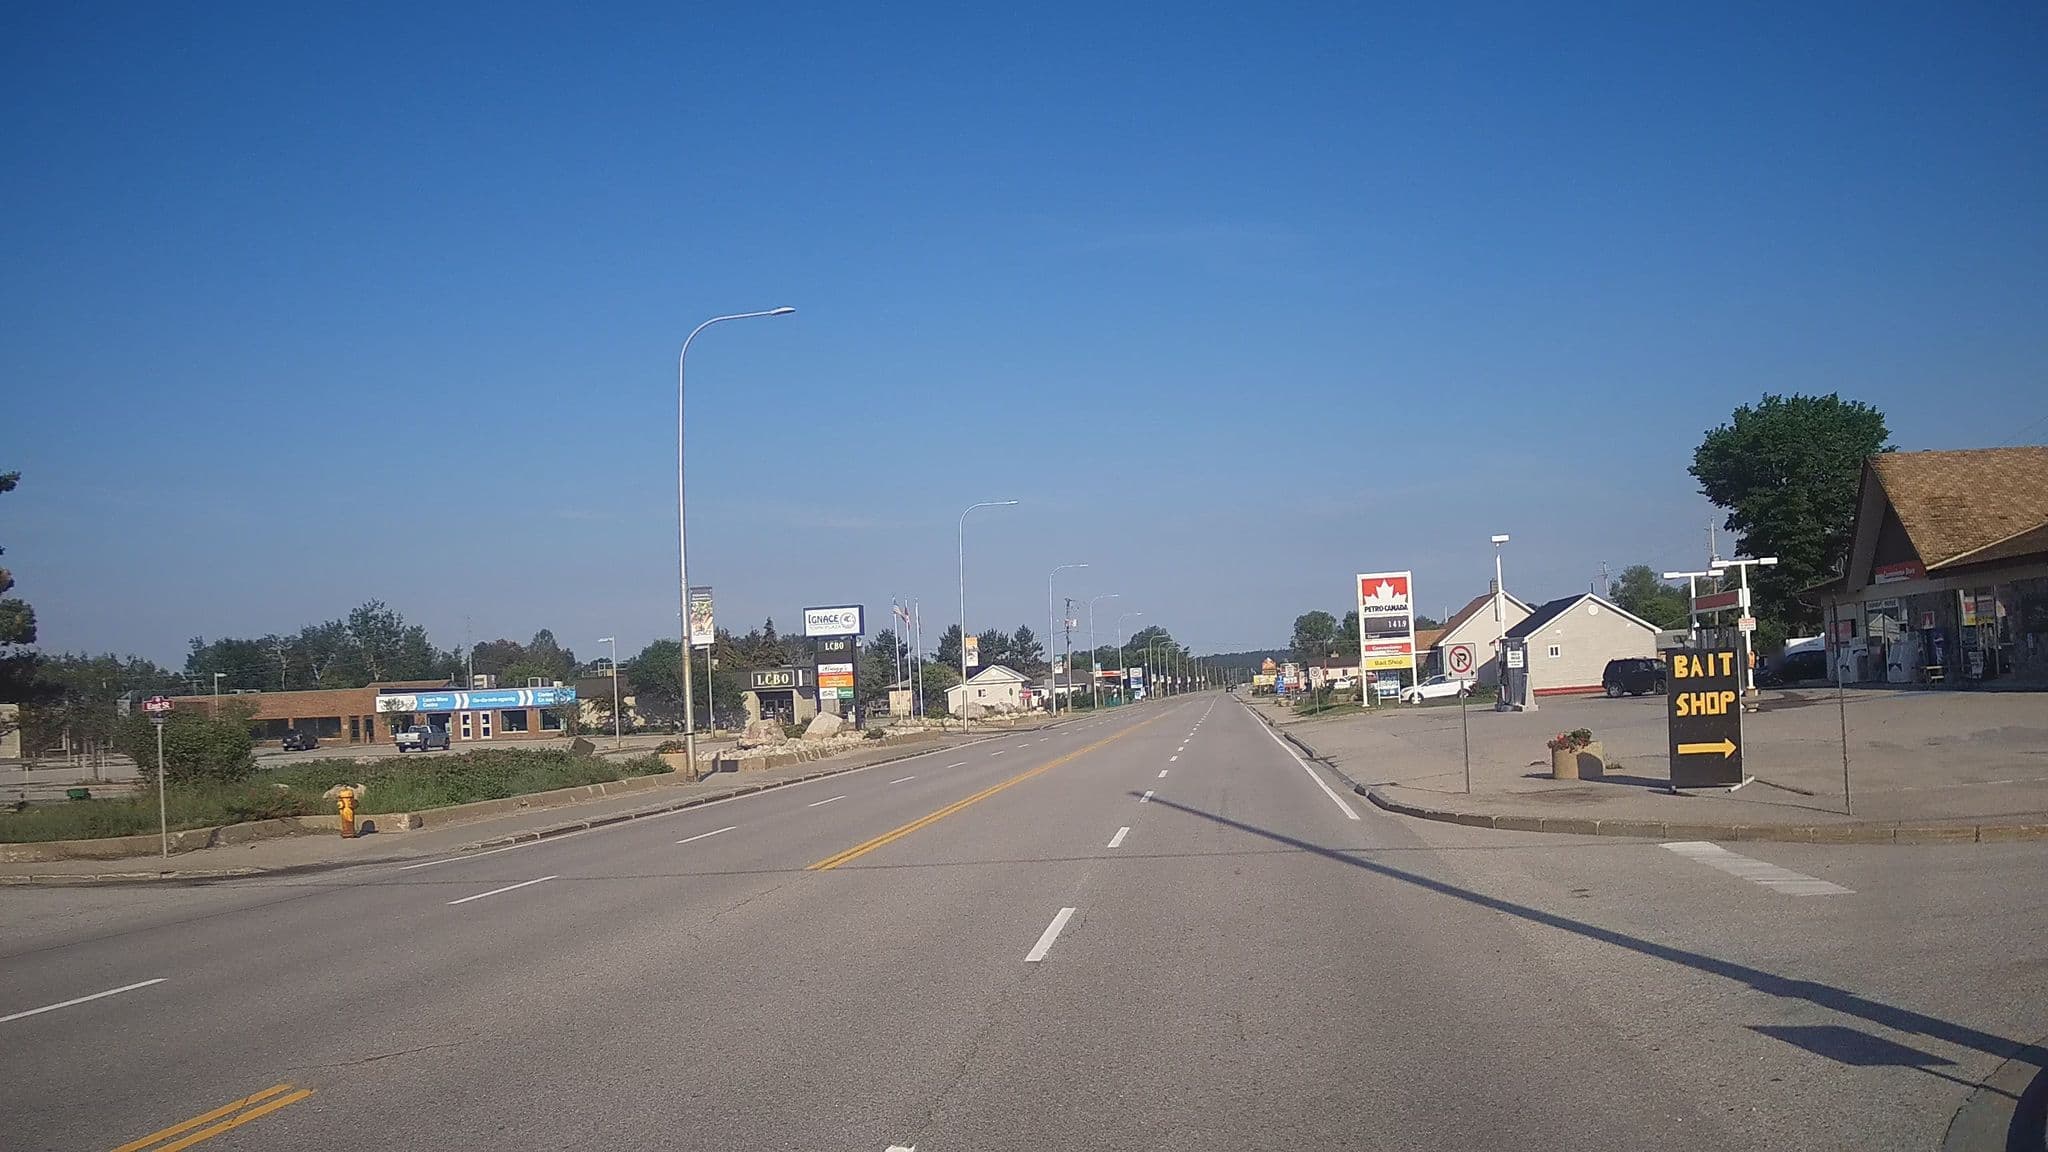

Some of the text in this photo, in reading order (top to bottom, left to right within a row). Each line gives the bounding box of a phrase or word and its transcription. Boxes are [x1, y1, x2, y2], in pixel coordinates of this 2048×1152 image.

[825, 642, 844, 650] LCBO
[1673, 652, 1734, 678] BAIT
[757, 673, 789, 686] LCBO
[1676, 690, 1736, 717] SHOP
